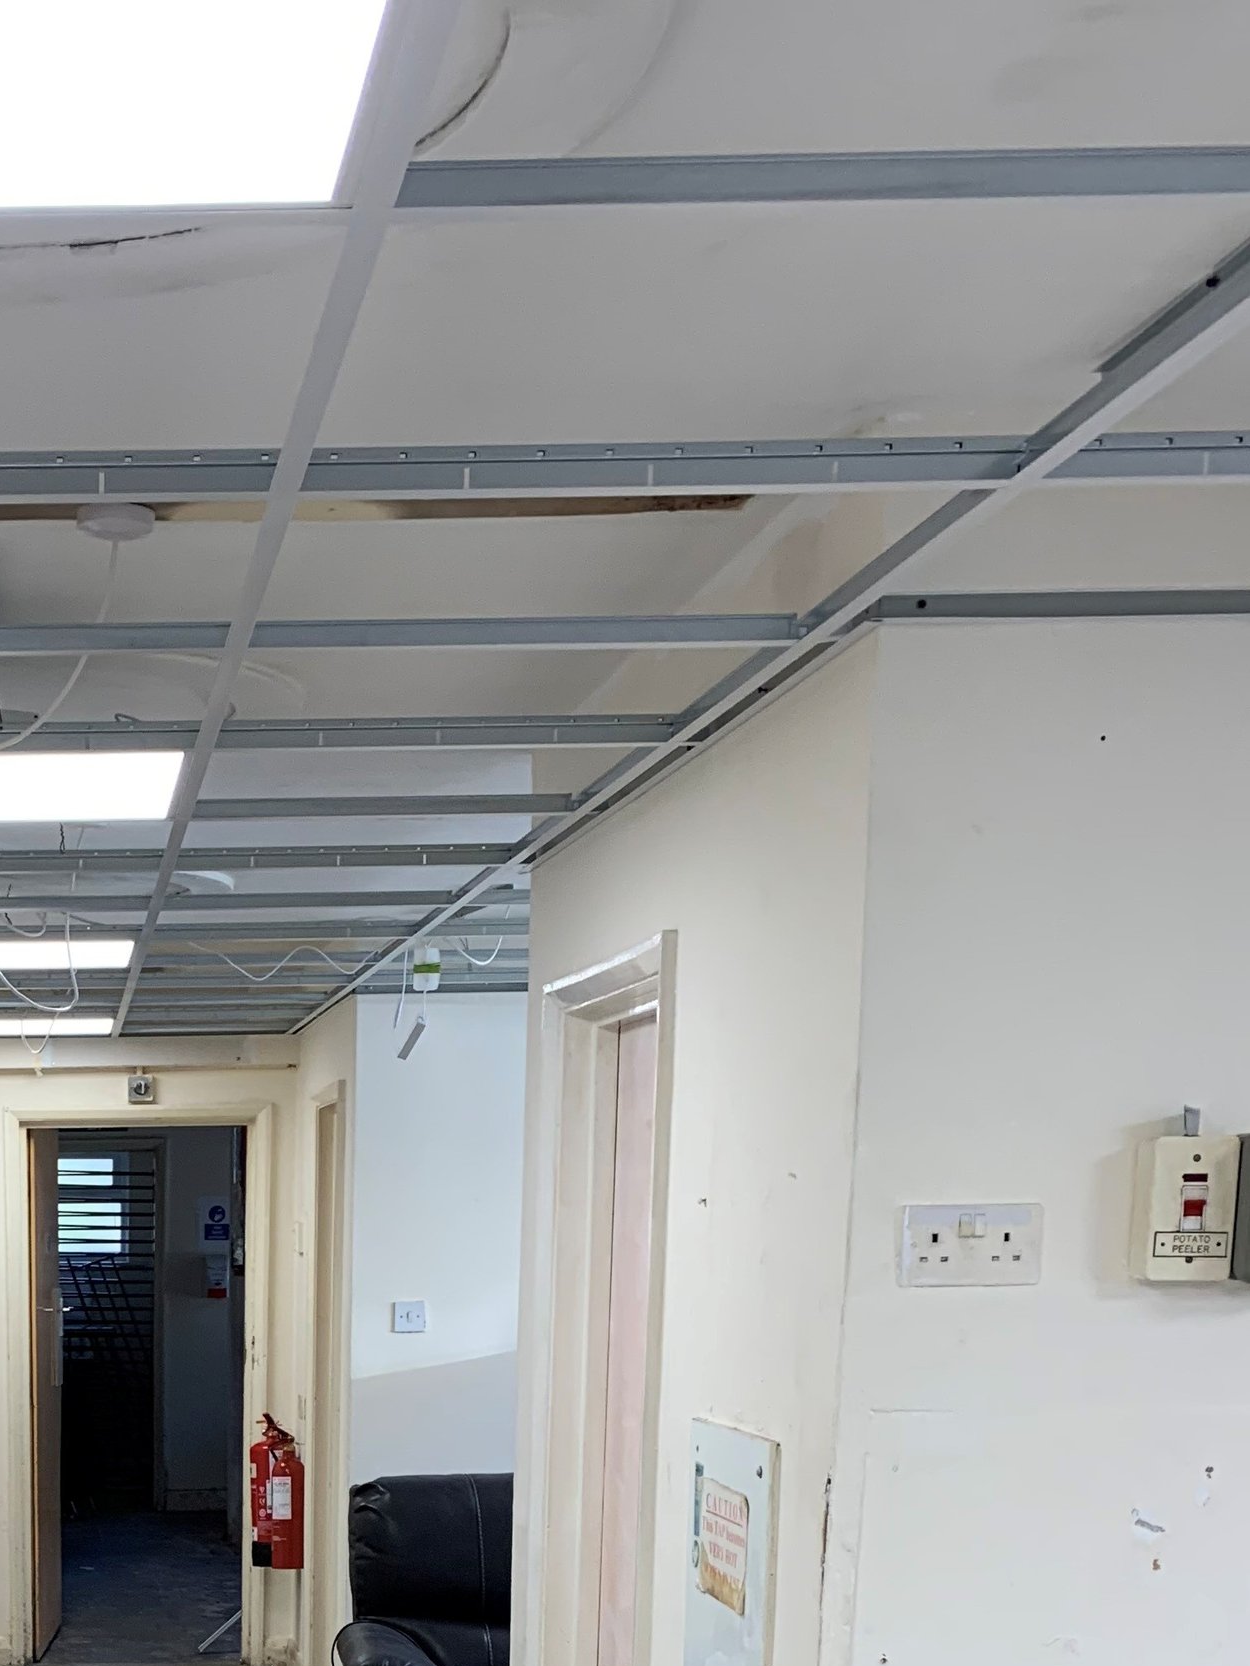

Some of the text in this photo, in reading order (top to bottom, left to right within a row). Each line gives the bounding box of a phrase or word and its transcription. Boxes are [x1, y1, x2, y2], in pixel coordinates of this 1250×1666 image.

[1173, 1235, 1211, 1243] POTATO
[1172, 1245, 1210, 1253] PEELER
[706, 1493, 743, 1521] CAUTION
